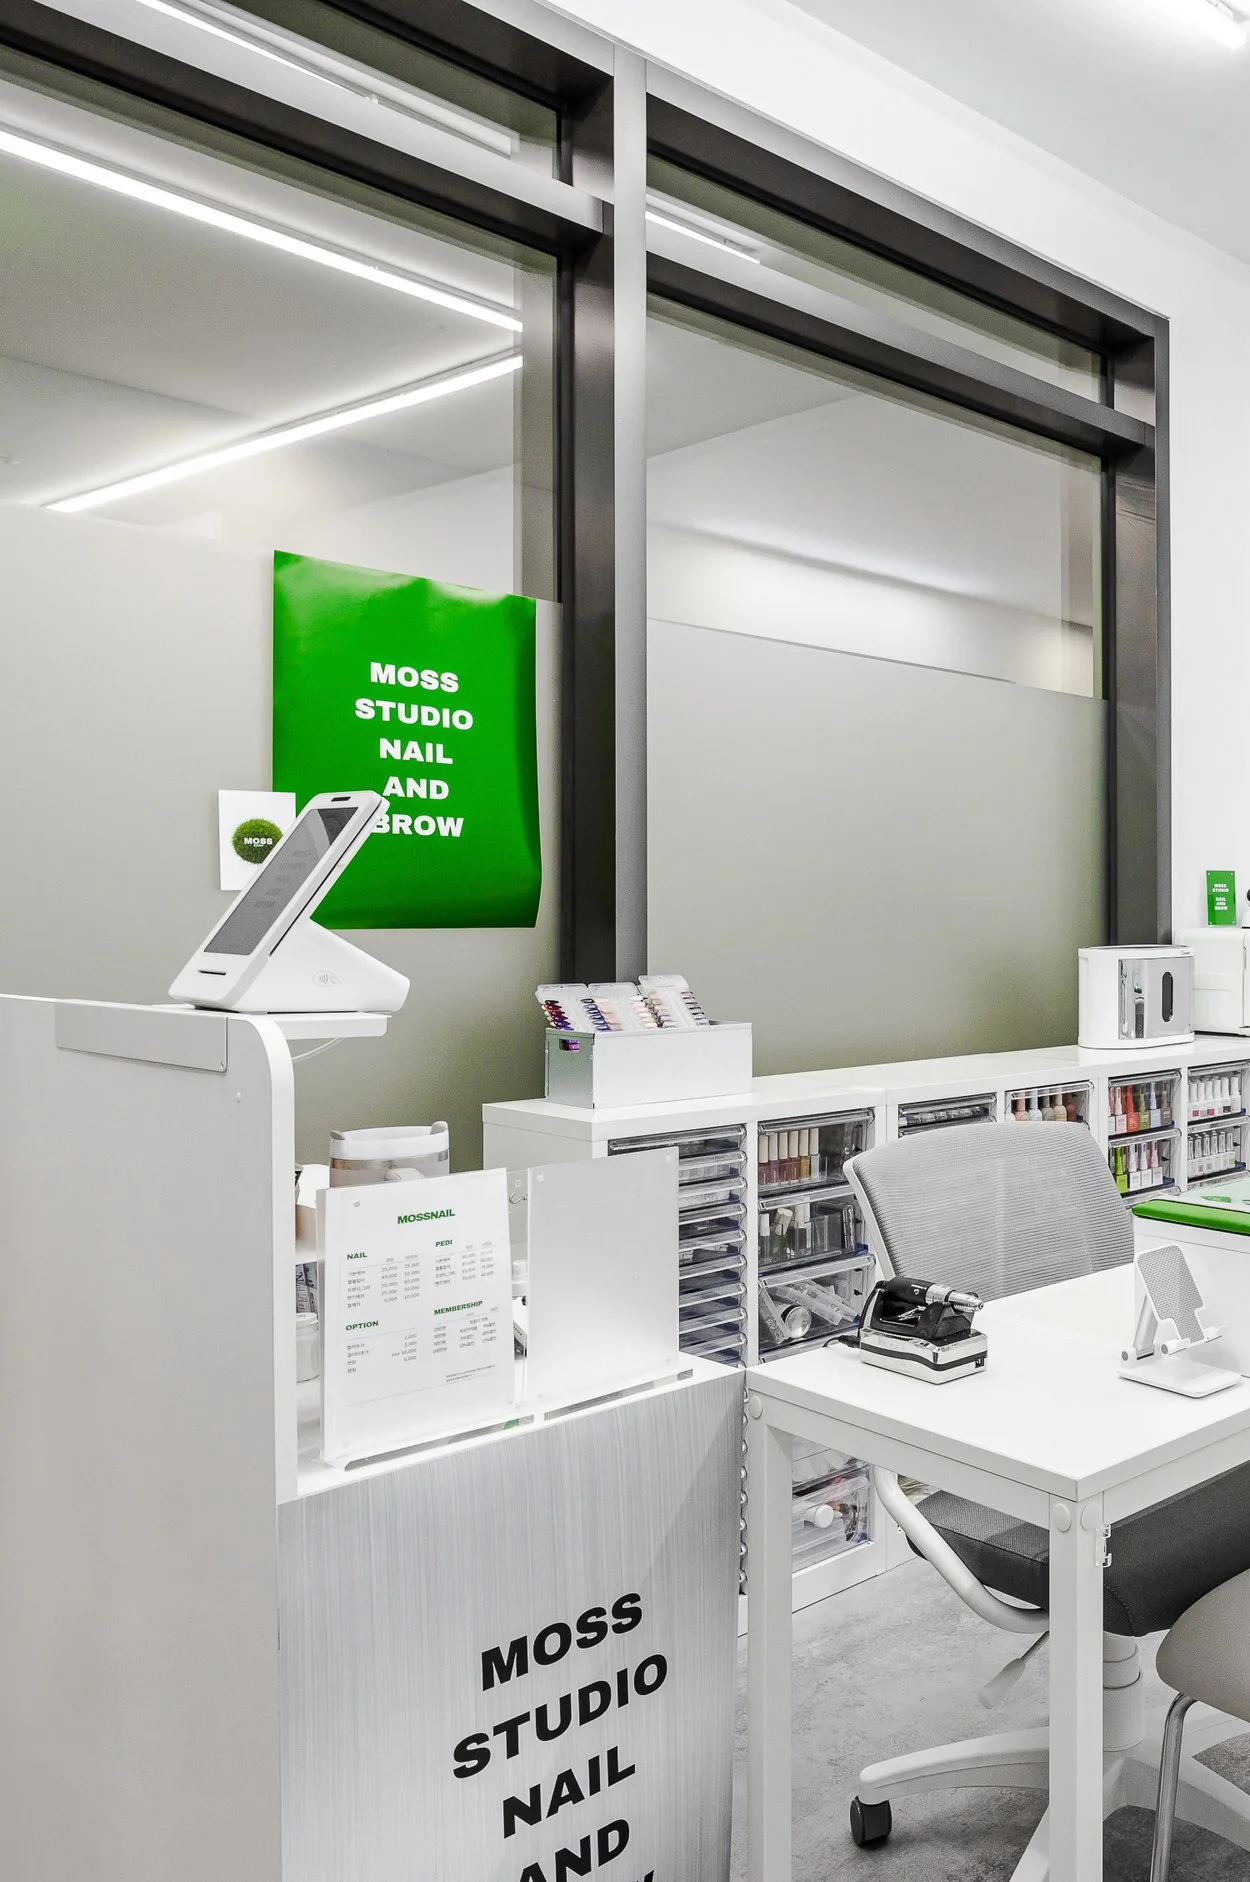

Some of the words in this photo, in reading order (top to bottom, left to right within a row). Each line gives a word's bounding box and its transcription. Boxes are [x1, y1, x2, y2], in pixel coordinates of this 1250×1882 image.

[370, 661, 460, 693] MOSS
[354, 697, 474, 731] STUDIO
[379, 737, 453, 765] NAIL
[382, 775, 449, 801] AND
[243, 837, 273, 845] MOSS
[397, 1208, 456, 1224] MOSSNAIL
[346, 1252, 368, 1260] NAIL
[435, 1239, 453, 1247] PEDI
[433, 1300, 483, 1315] MEMBERSHIP
[345, 1320, 379, 1331] OPTION
[481, 1592, 643, 1692] MOSS
[453, 1653, 668, 1779] STUDIO
[502, 1745, 636, 1839] NAIL
